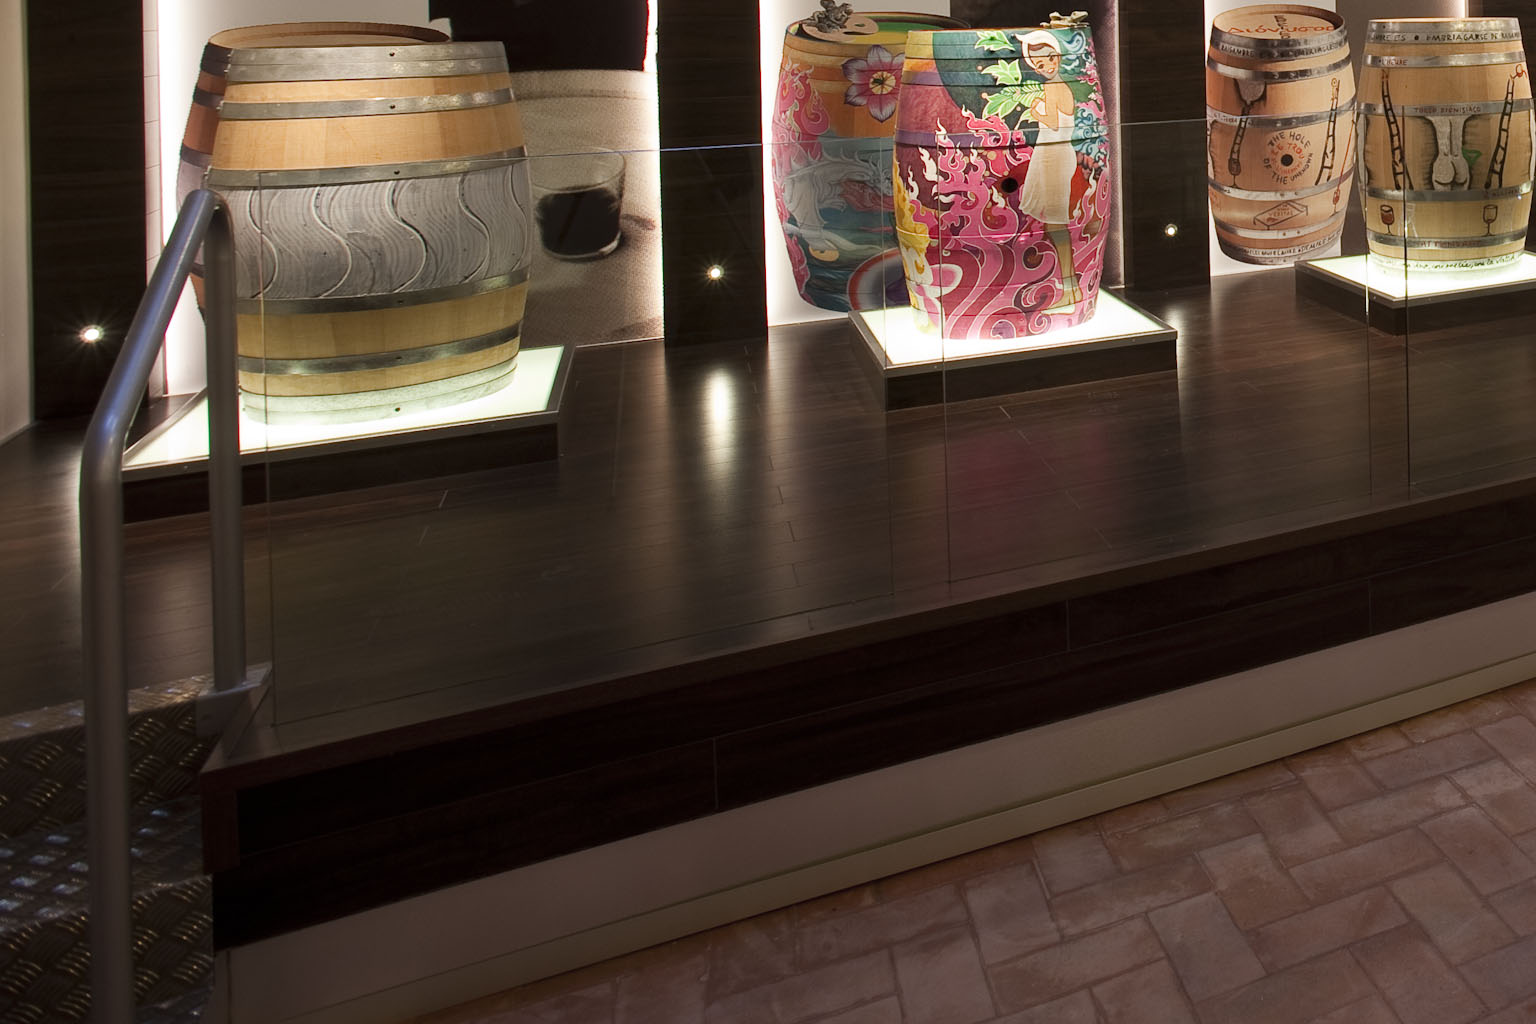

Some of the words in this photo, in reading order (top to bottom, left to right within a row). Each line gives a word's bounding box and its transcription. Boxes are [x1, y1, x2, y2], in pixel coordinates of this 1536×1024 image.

[1268, 131, 1285, 147] THE
[1289, 131, 1311, 150] HOLE
[1271, 171, 1289, 185] THE
